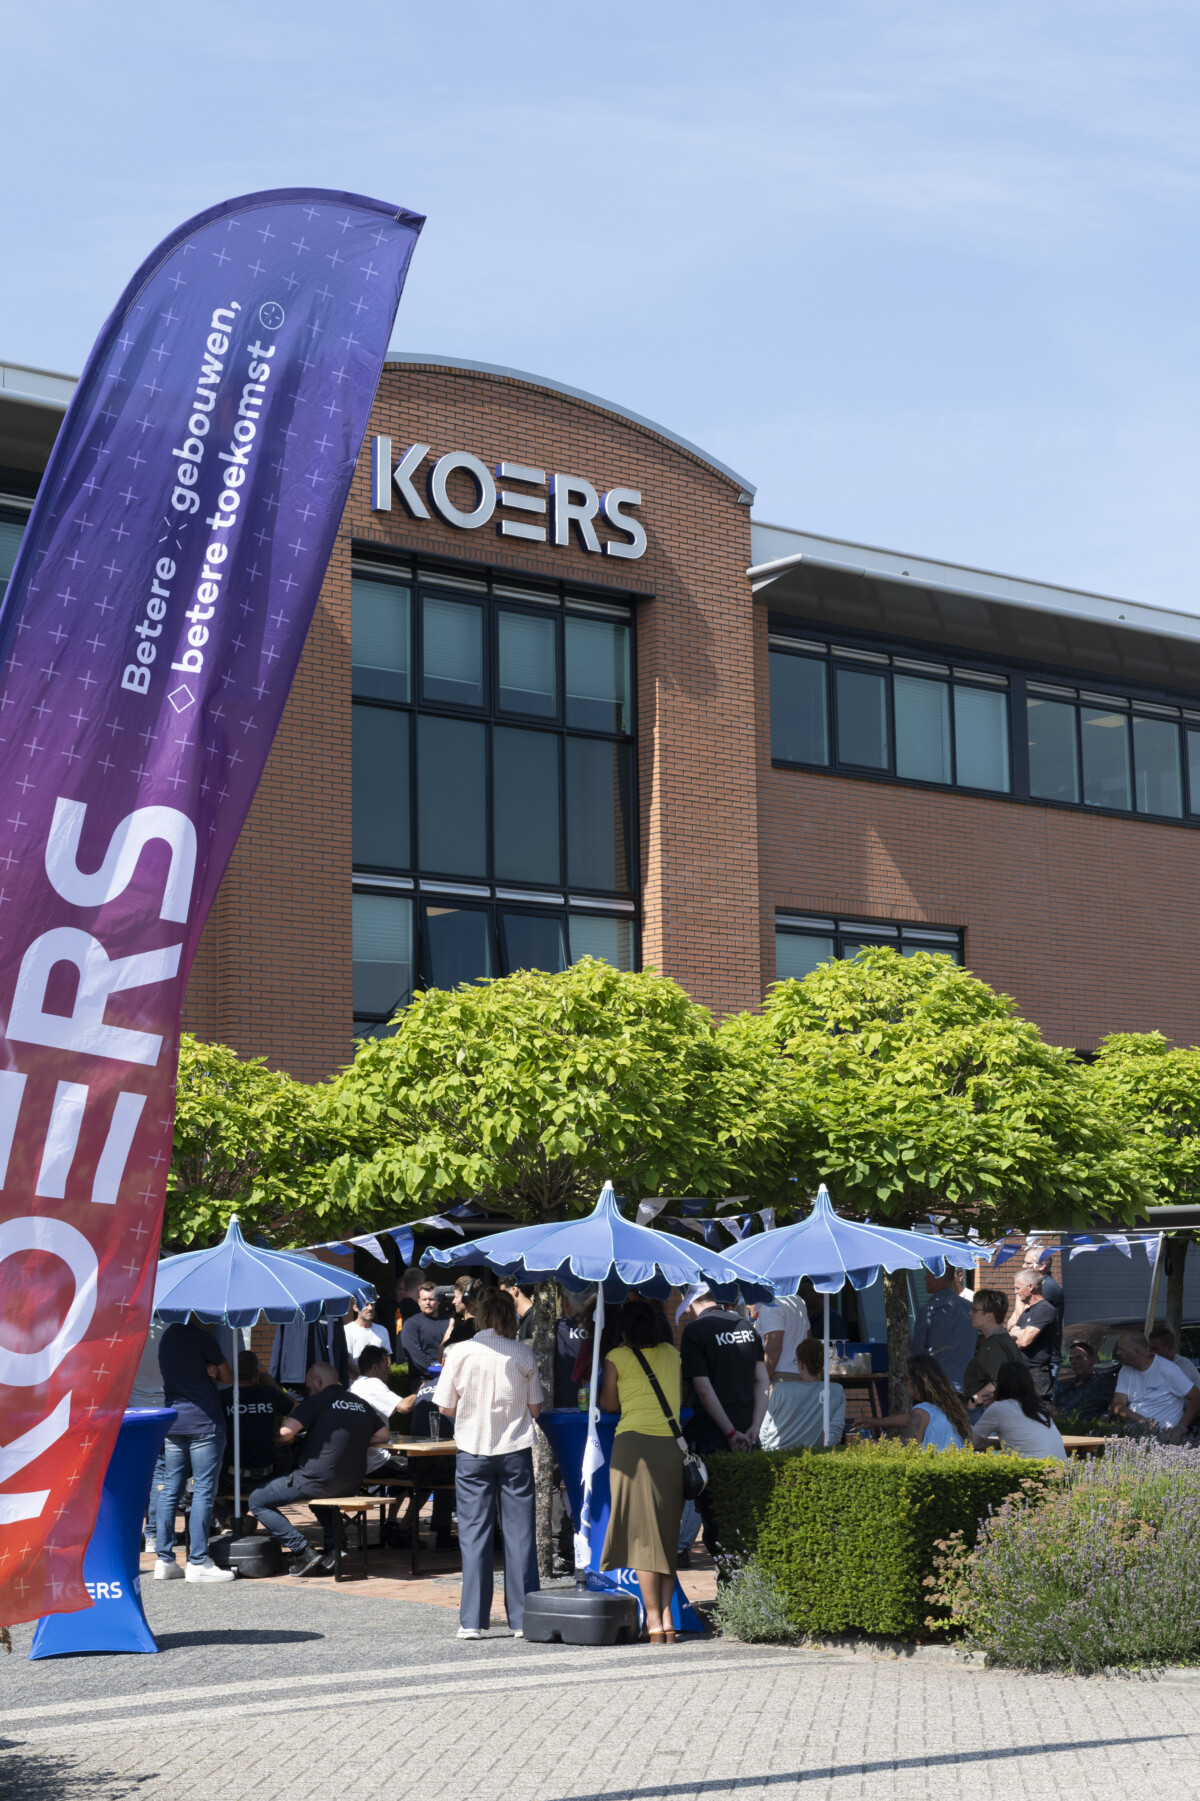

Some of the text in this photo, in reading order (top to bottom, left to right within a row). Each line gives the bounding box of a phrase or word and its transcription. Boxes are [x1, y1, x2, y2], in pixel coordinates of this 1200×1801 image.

[121, 301, 242, 695] Betere gebouwen,
[171, 340, 276, 673] betere toekomst
[372, 435, 648, 559] KOERS
[715, 1329, 755, 1346] KOERS
[331, 1399, 366, 1413] KOERS
